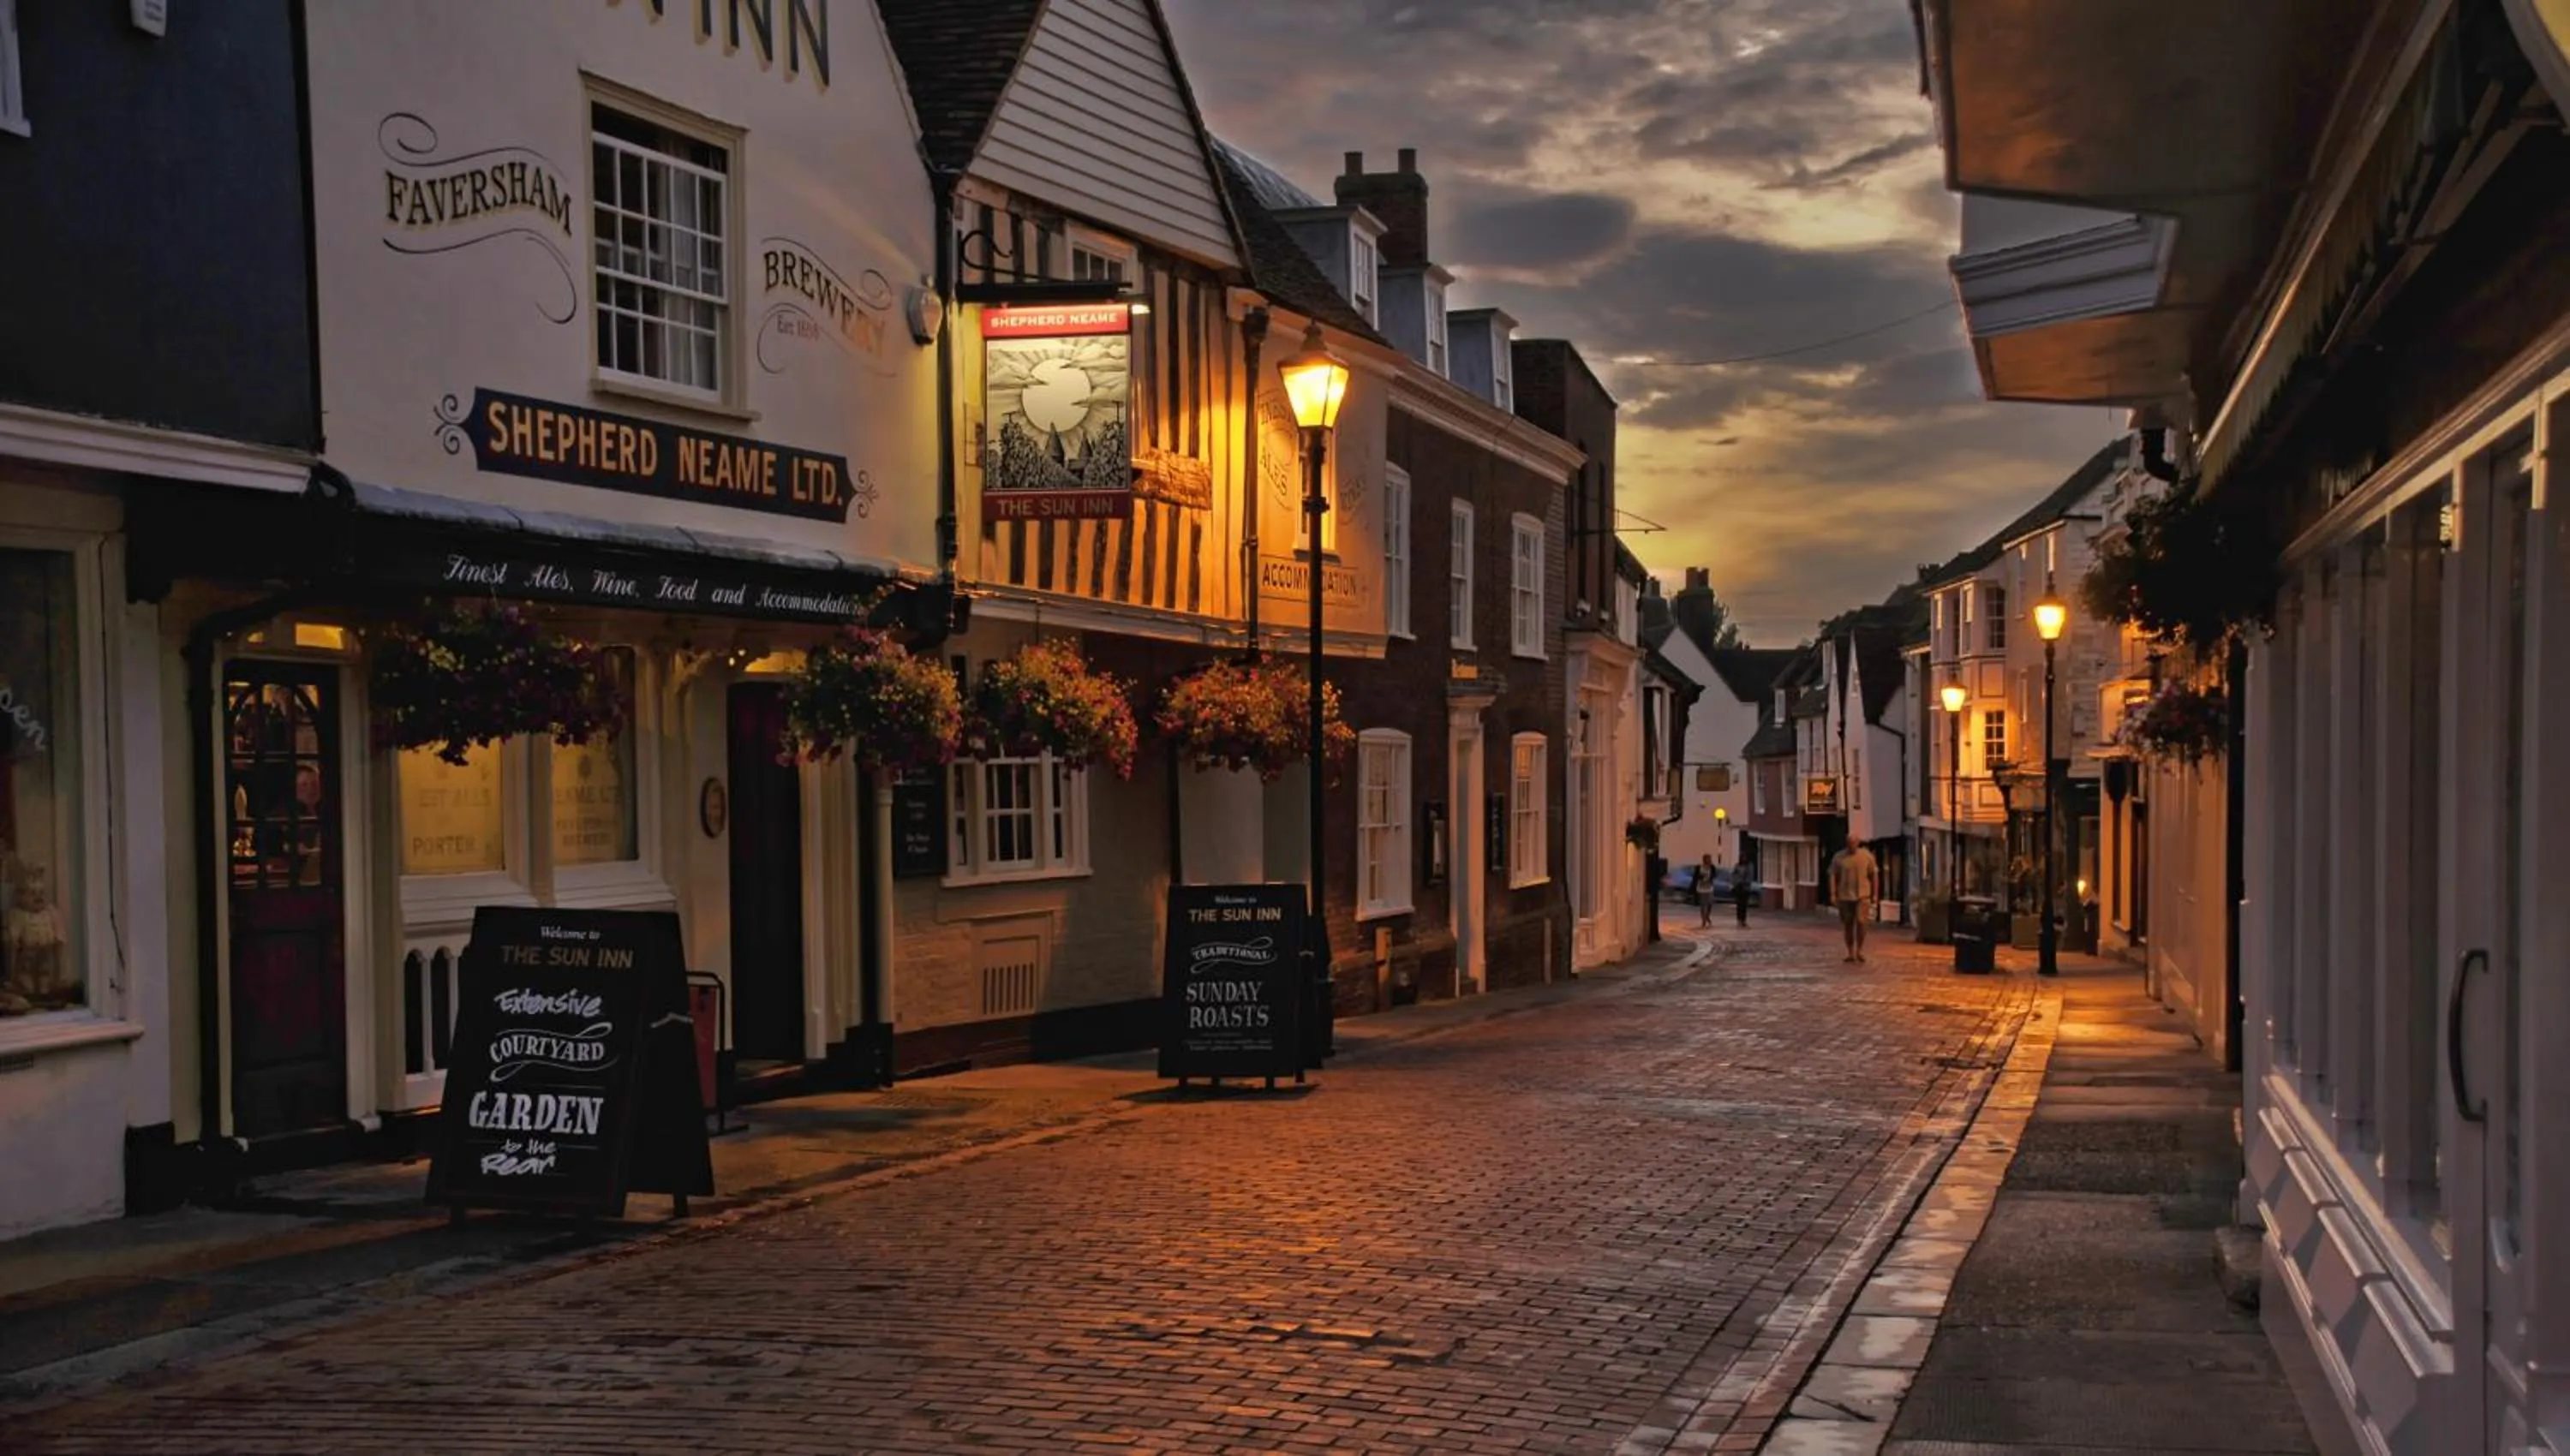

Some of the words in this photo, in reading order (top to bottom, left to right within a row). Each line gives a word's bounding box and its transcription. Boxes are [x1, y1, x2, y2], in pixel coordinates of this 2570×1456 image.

[385, 162, 572, 238] FAVERSHAM
[990, 315, 1065, 329] SHEPHERD
[1070, 311, 1118, 325] NEAME
[487, 400, 659, 477] SHEPHERD
[677, 434, 779, 497] NEAME
[792, 456, 844, 507] LTD.
[998, 497, 1033, 516] THE
[1038, 496, 1076, 516] SUN
[1083, 497, 1114, 514] INN
[442, 552, 509, 583] Finest
[655, 575, 699, 601] Food
[711, 582, 748, 604] and
[1262, 561, 1357, 597] ACCOMATION
[1188, 909, 1218, 922] THE
[1222, 908, 1252, 922] SUN
[1257, 908, 1282, 921] INN
[500, 945, 542, 965] THE
[547, 946, 590, 967] SUN
[596, 948, 634, 969] INN
[493, 988, 604, 1018] Extensive
[1186, 981, 1264, 1003] SUNDAY
[1189, 1005, 1270, 1029] ROASTS
[489, 1034, 605, 1063] COURTYARD
[468, 1089, 605, 1135] GARDEN
[499, 1137, 523, 1154] to
[525, 1138, 557, 1155] the
[480, 1153, 557, 1176] Rear
